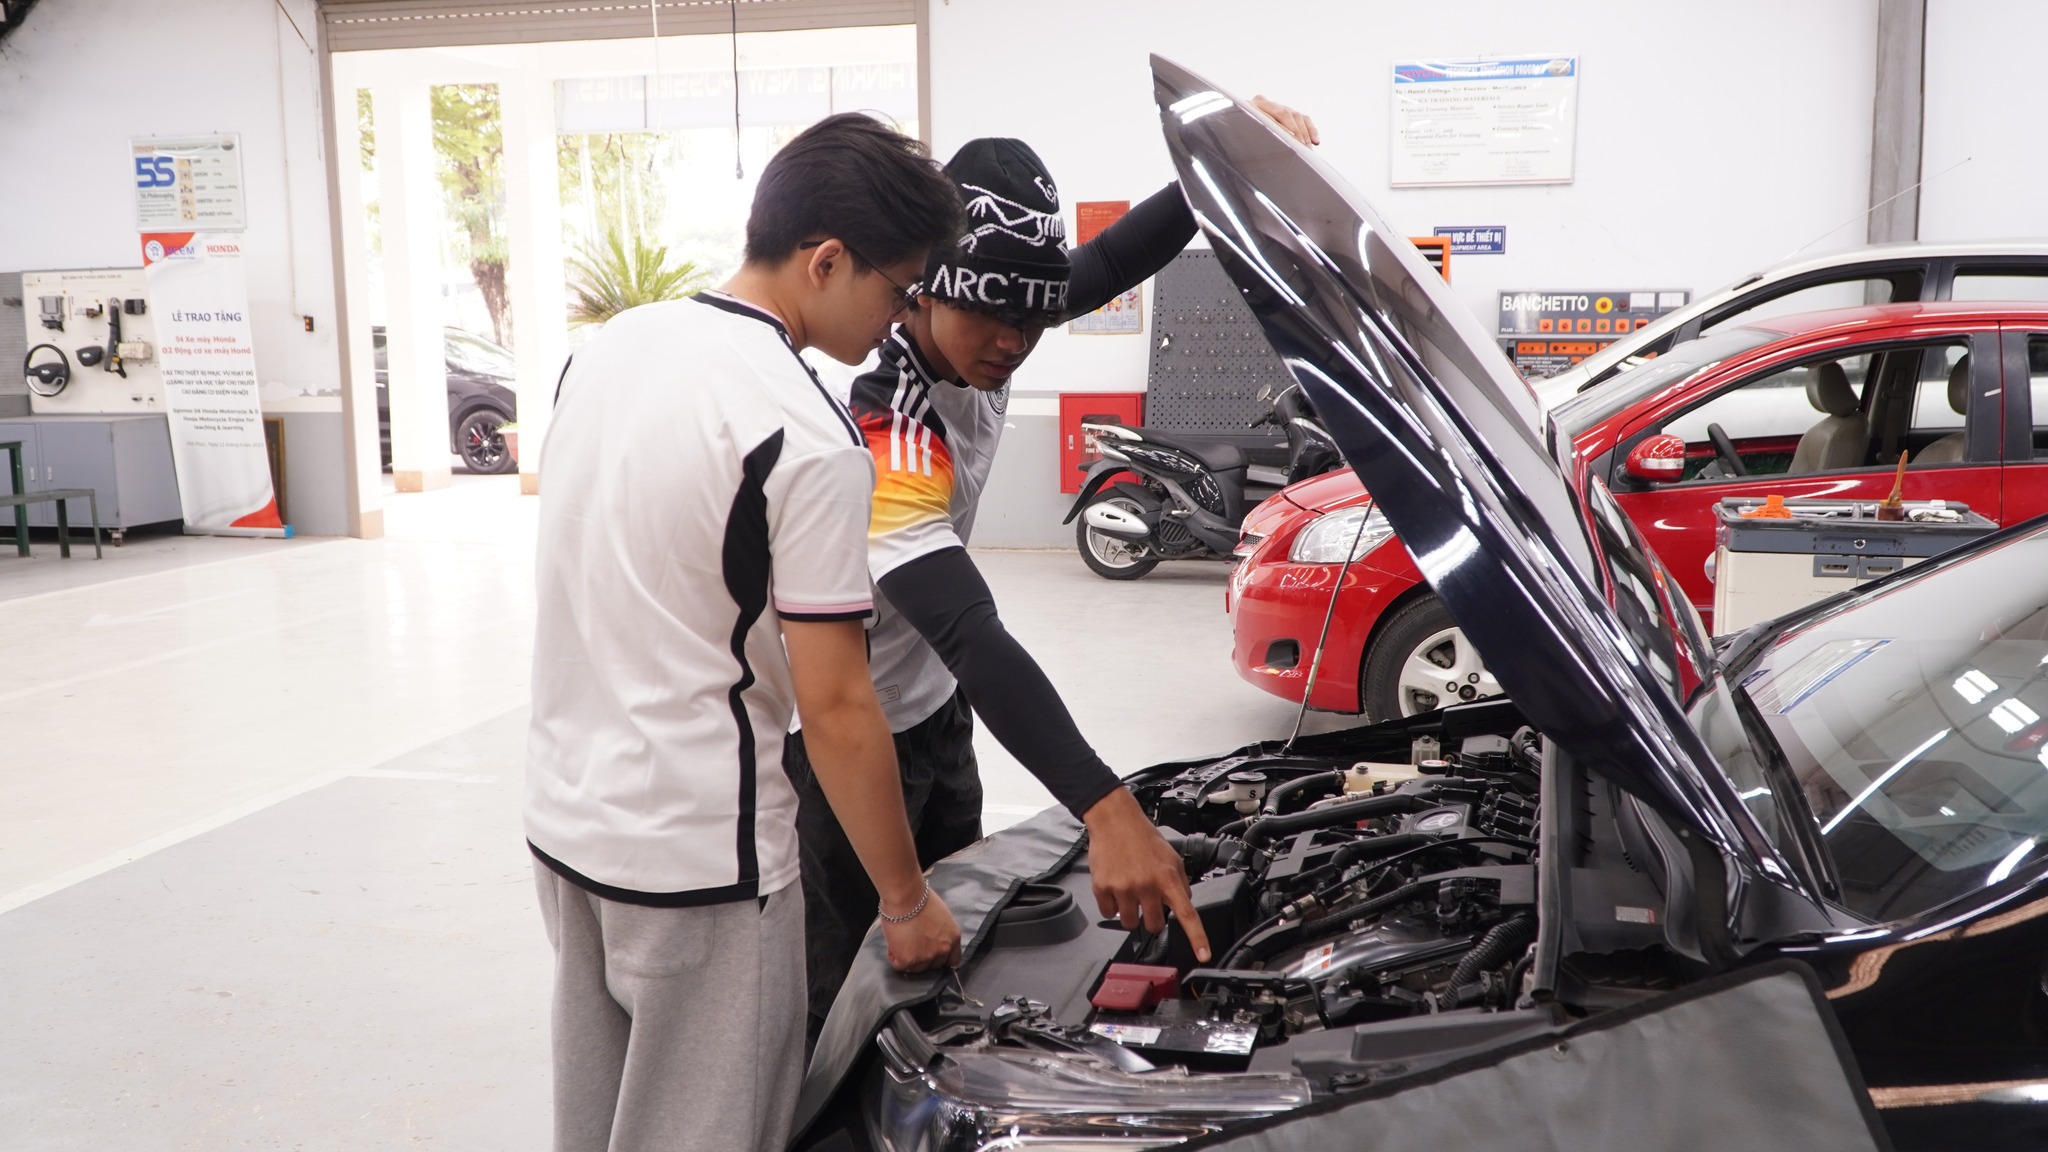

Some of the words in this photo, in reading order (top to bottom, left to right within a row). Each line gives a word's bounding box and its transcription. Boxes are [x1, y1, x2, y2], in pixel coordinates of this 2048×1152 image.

[135, 156, 176, 188] 5S
[207, 244, 240, 253] HONDA
[1502, 295, 1589, 312] BANCHETTO
[185, 312, 211, 322] TRAO
[1249, 789, 1257, 799] S
